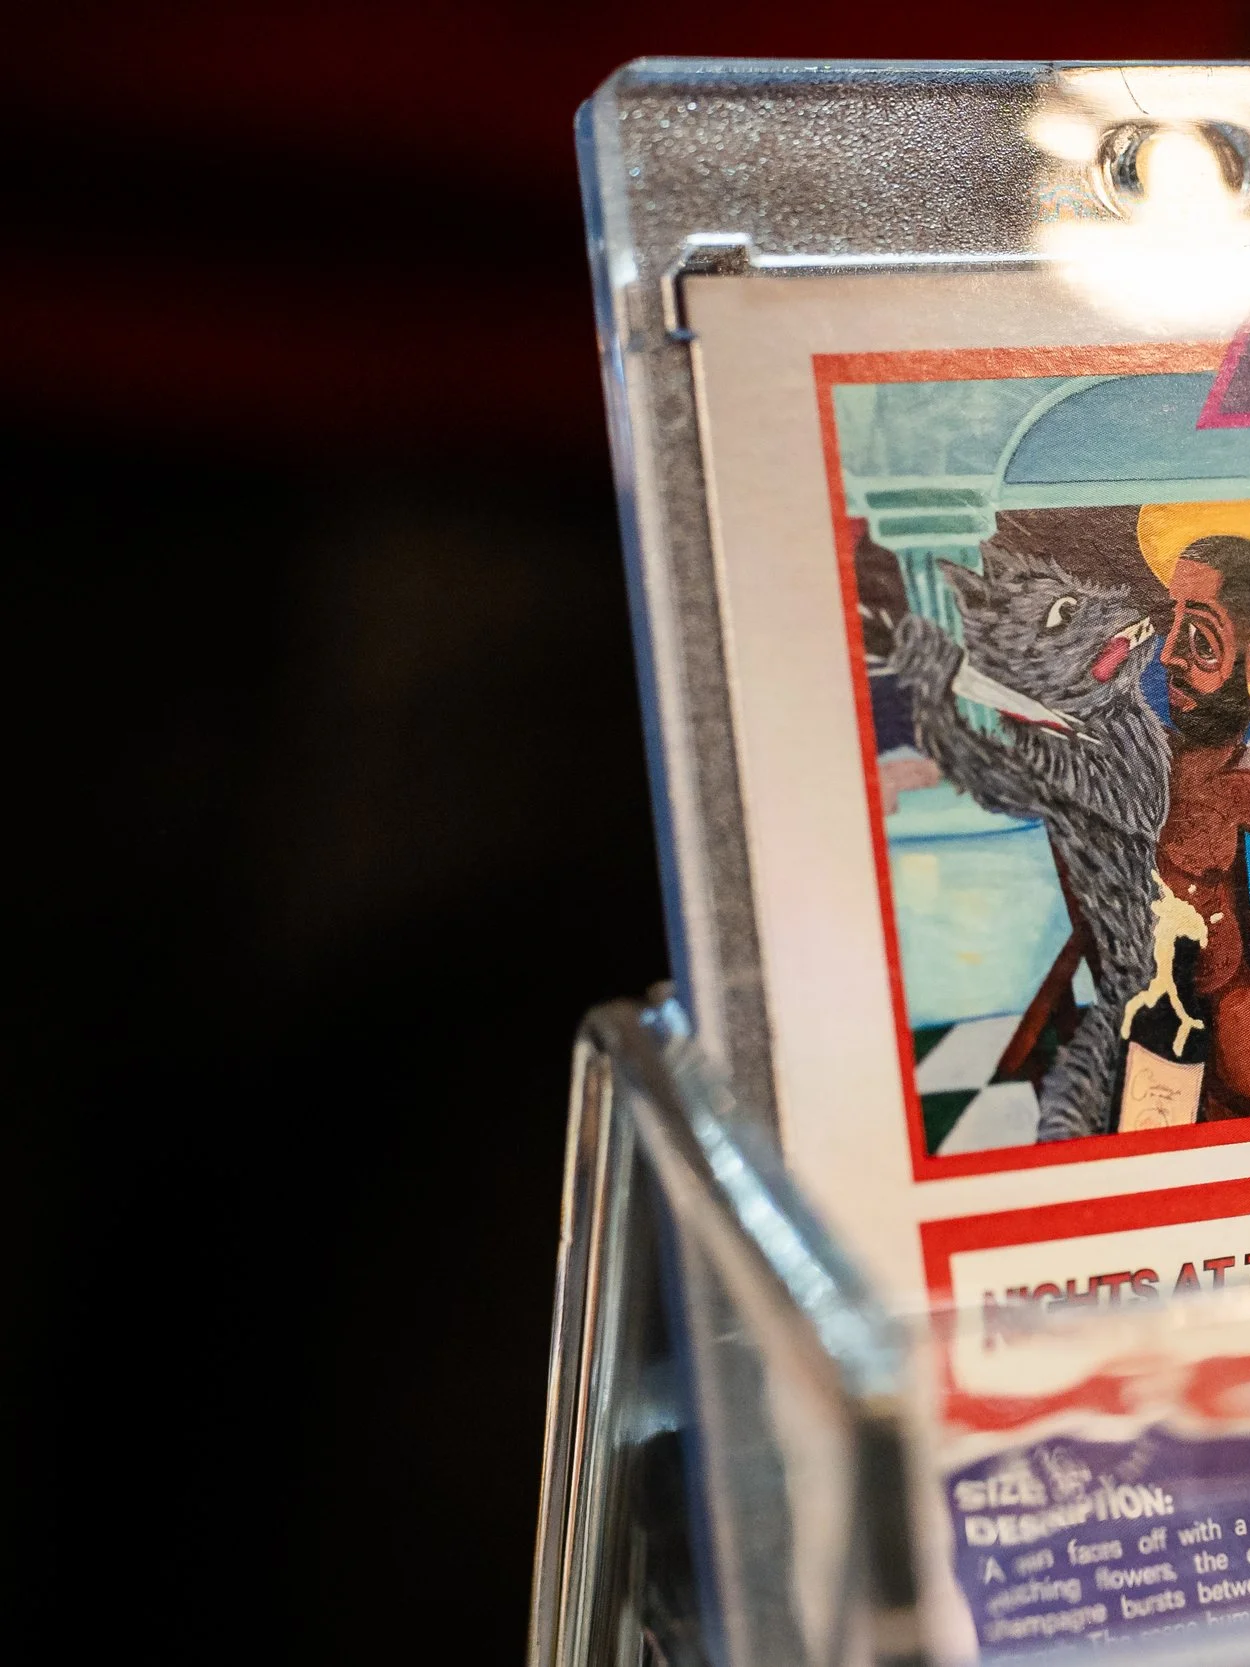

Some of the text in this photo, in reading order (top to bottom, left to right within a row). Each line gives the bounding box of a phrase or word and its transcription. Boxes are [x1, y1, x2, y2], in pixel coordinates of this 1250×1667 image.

[1138, 1526, 1168, 1555] off
[1178, 1516, 1222, 1547] with
[1234, 1518, 1247, 1537] a
[1193, 1551, 1229, 1574] the
